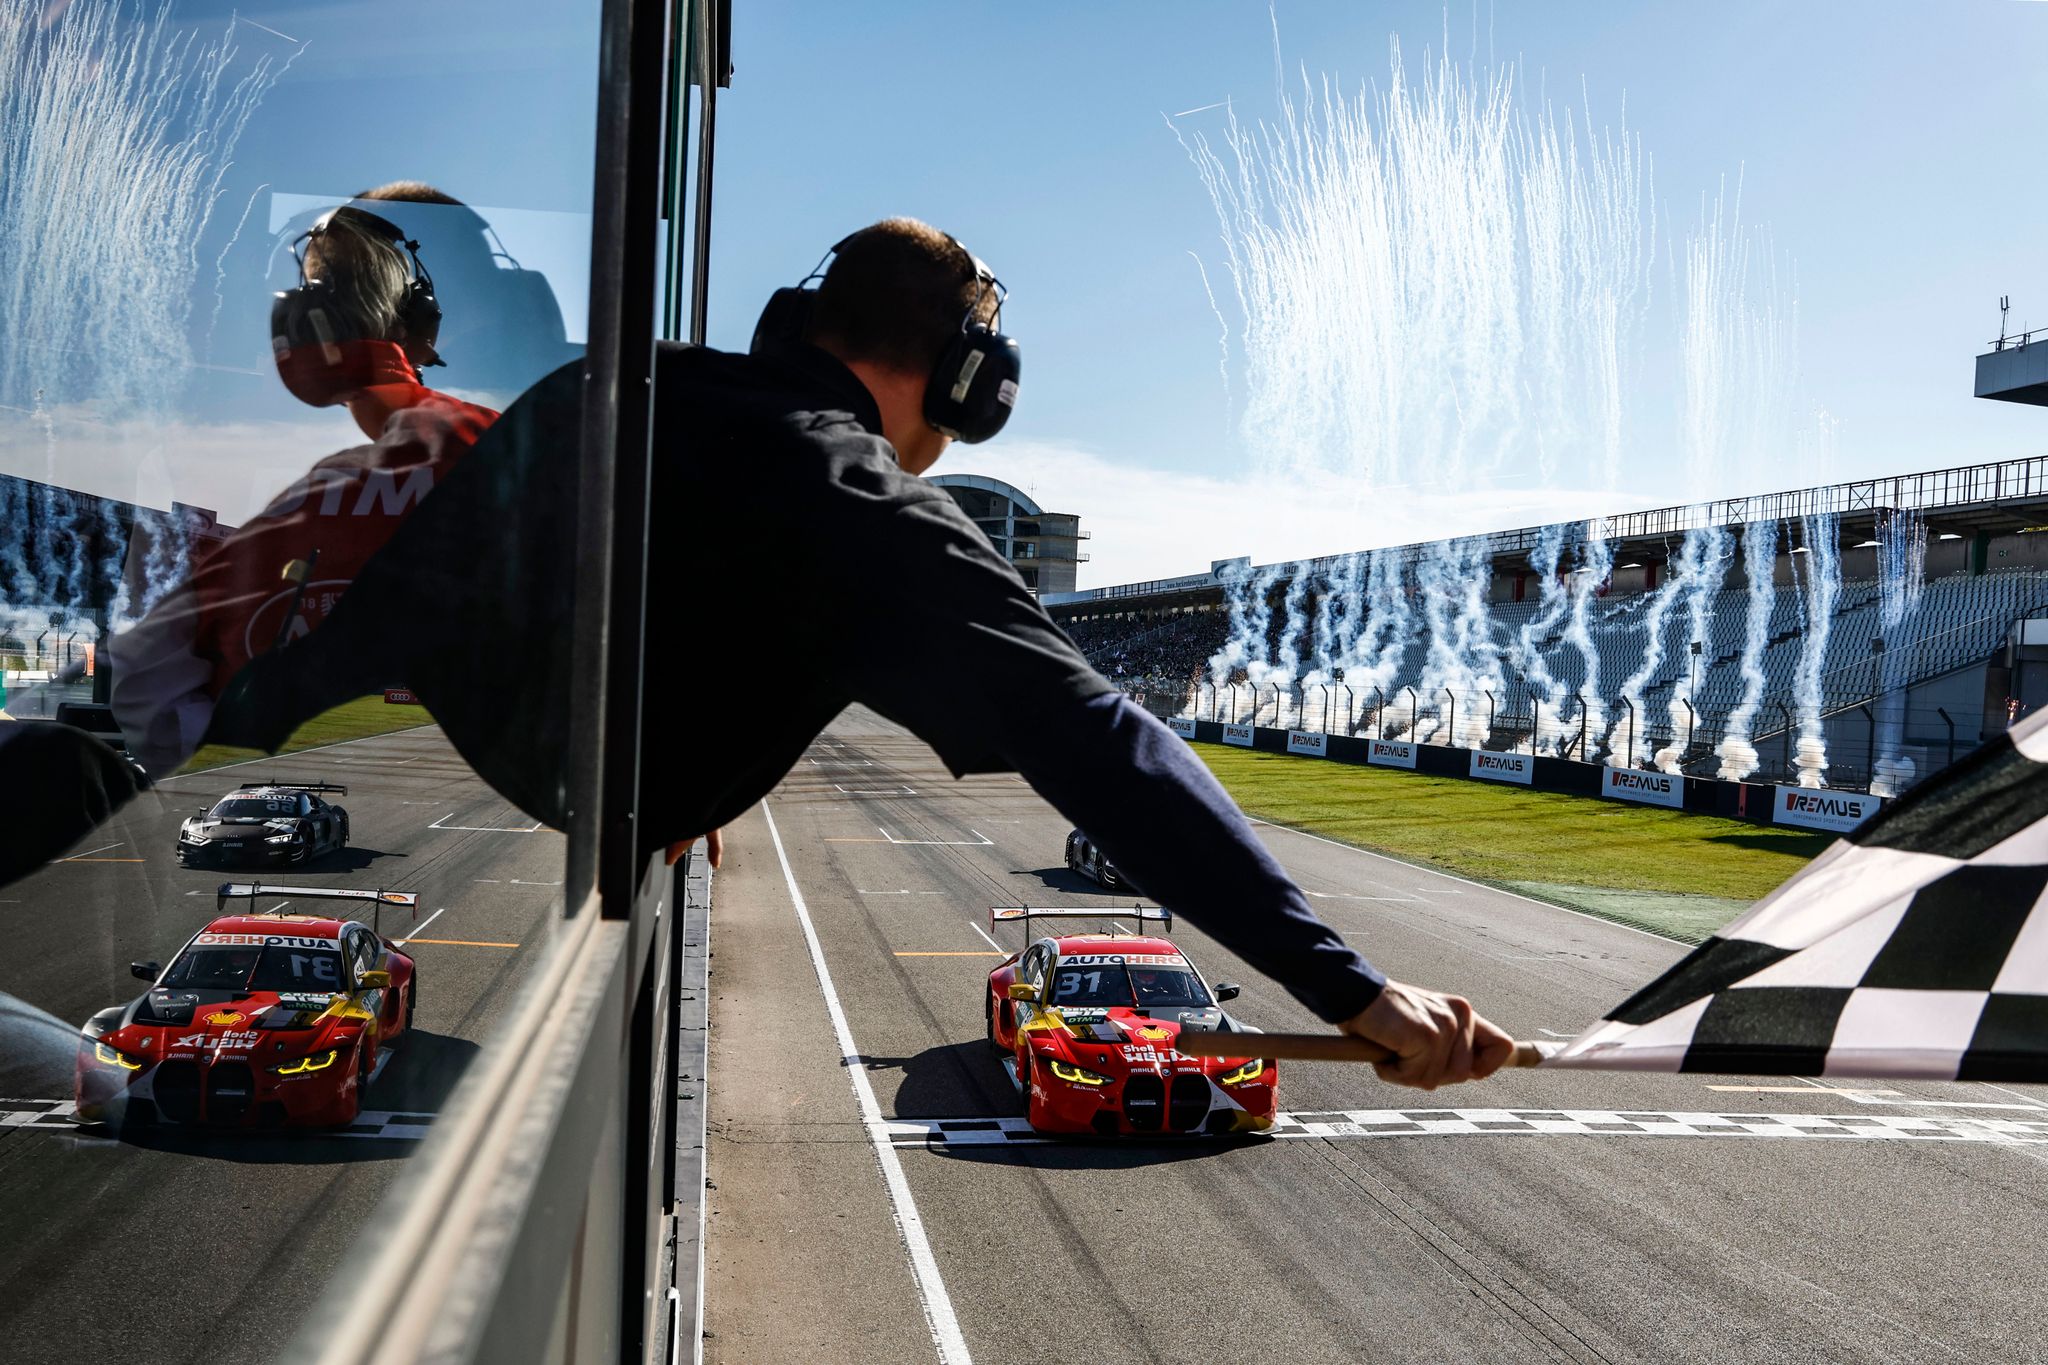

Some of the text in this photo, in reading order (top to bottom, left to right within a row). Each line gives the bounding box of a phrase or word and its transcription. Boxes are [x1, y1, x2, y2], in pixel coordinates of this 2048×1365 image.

[1296, 736, 1321, 747] REMUS
[1377, 745, 1409, 758] REMUS
[1483, 757, 1523, 772] REMUS
[1618, 773, 1671, 793] REMUS
[1794, 795, 1862, 819] REMUS
[1063, 955, 1184, 966] AUTOHERO
[1058, 971, 1102, 996] 31
[1068, 1016, 1093, 1024] DTM
[1123, 1044, 1155, 1053] Shell
[1125, 1050, 1199, 1063] HELIX
